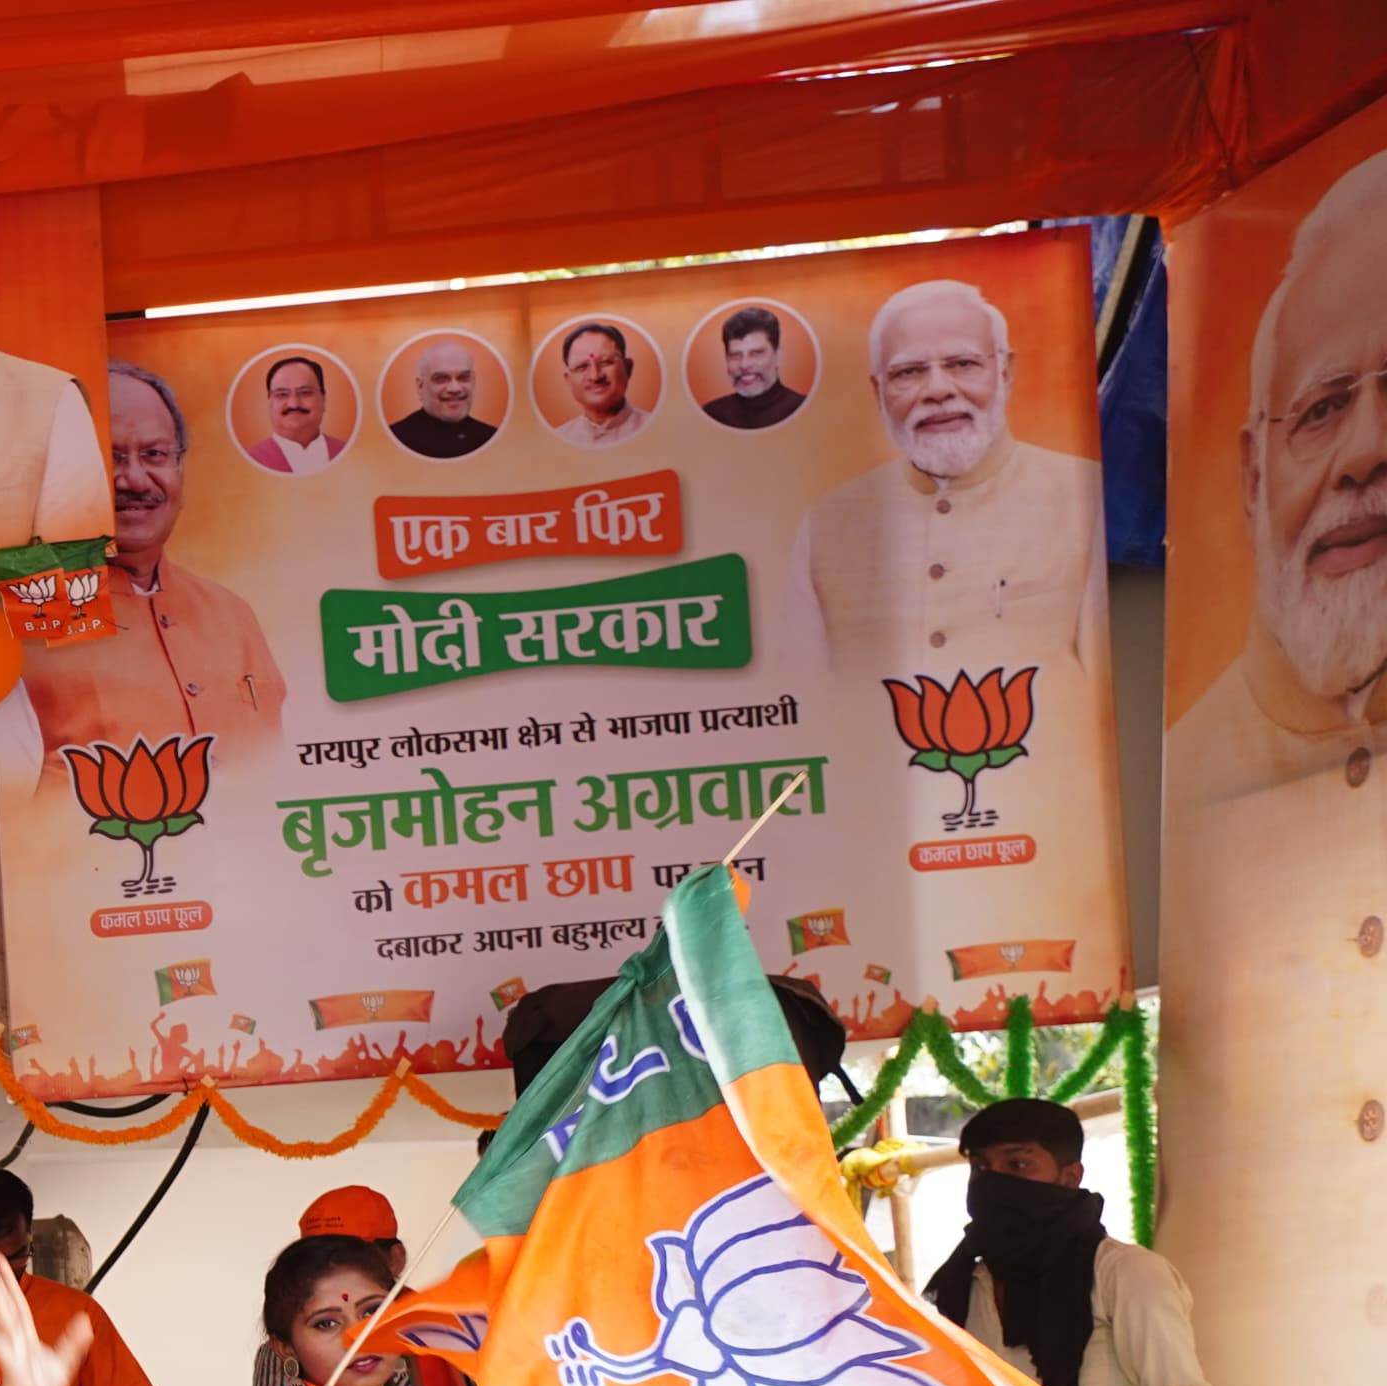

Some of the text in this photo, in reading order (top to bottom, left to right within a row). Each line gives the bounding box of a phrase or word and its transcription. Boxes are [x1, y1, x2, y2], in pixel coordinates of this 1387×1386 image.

[390, 489, 665, 566] एक बार फिर
[347, 595, 724, 676] मोदी सरकार
[297, 695, 798, 769] रायपुर लोकसभा क्षेत्र से भाजपा प्रत्याशी
[277, 756, 829, 878] बृजमोहन अग्रवाल
[353, 880, 393, 914] को
[400, 863, 530, 910] कमल
[542, 854, 635, 898] छाप
[918, 845, 962, 864] कमल
[996, 839, 1027, 864] फूल
[99, 905, 203, 930] कमल छाप फूल
[376, 933, 463, 960] दबाकर
[472, 926, 543, 953] अपना
[551, 915, 647, 951] बहुमूल्य
